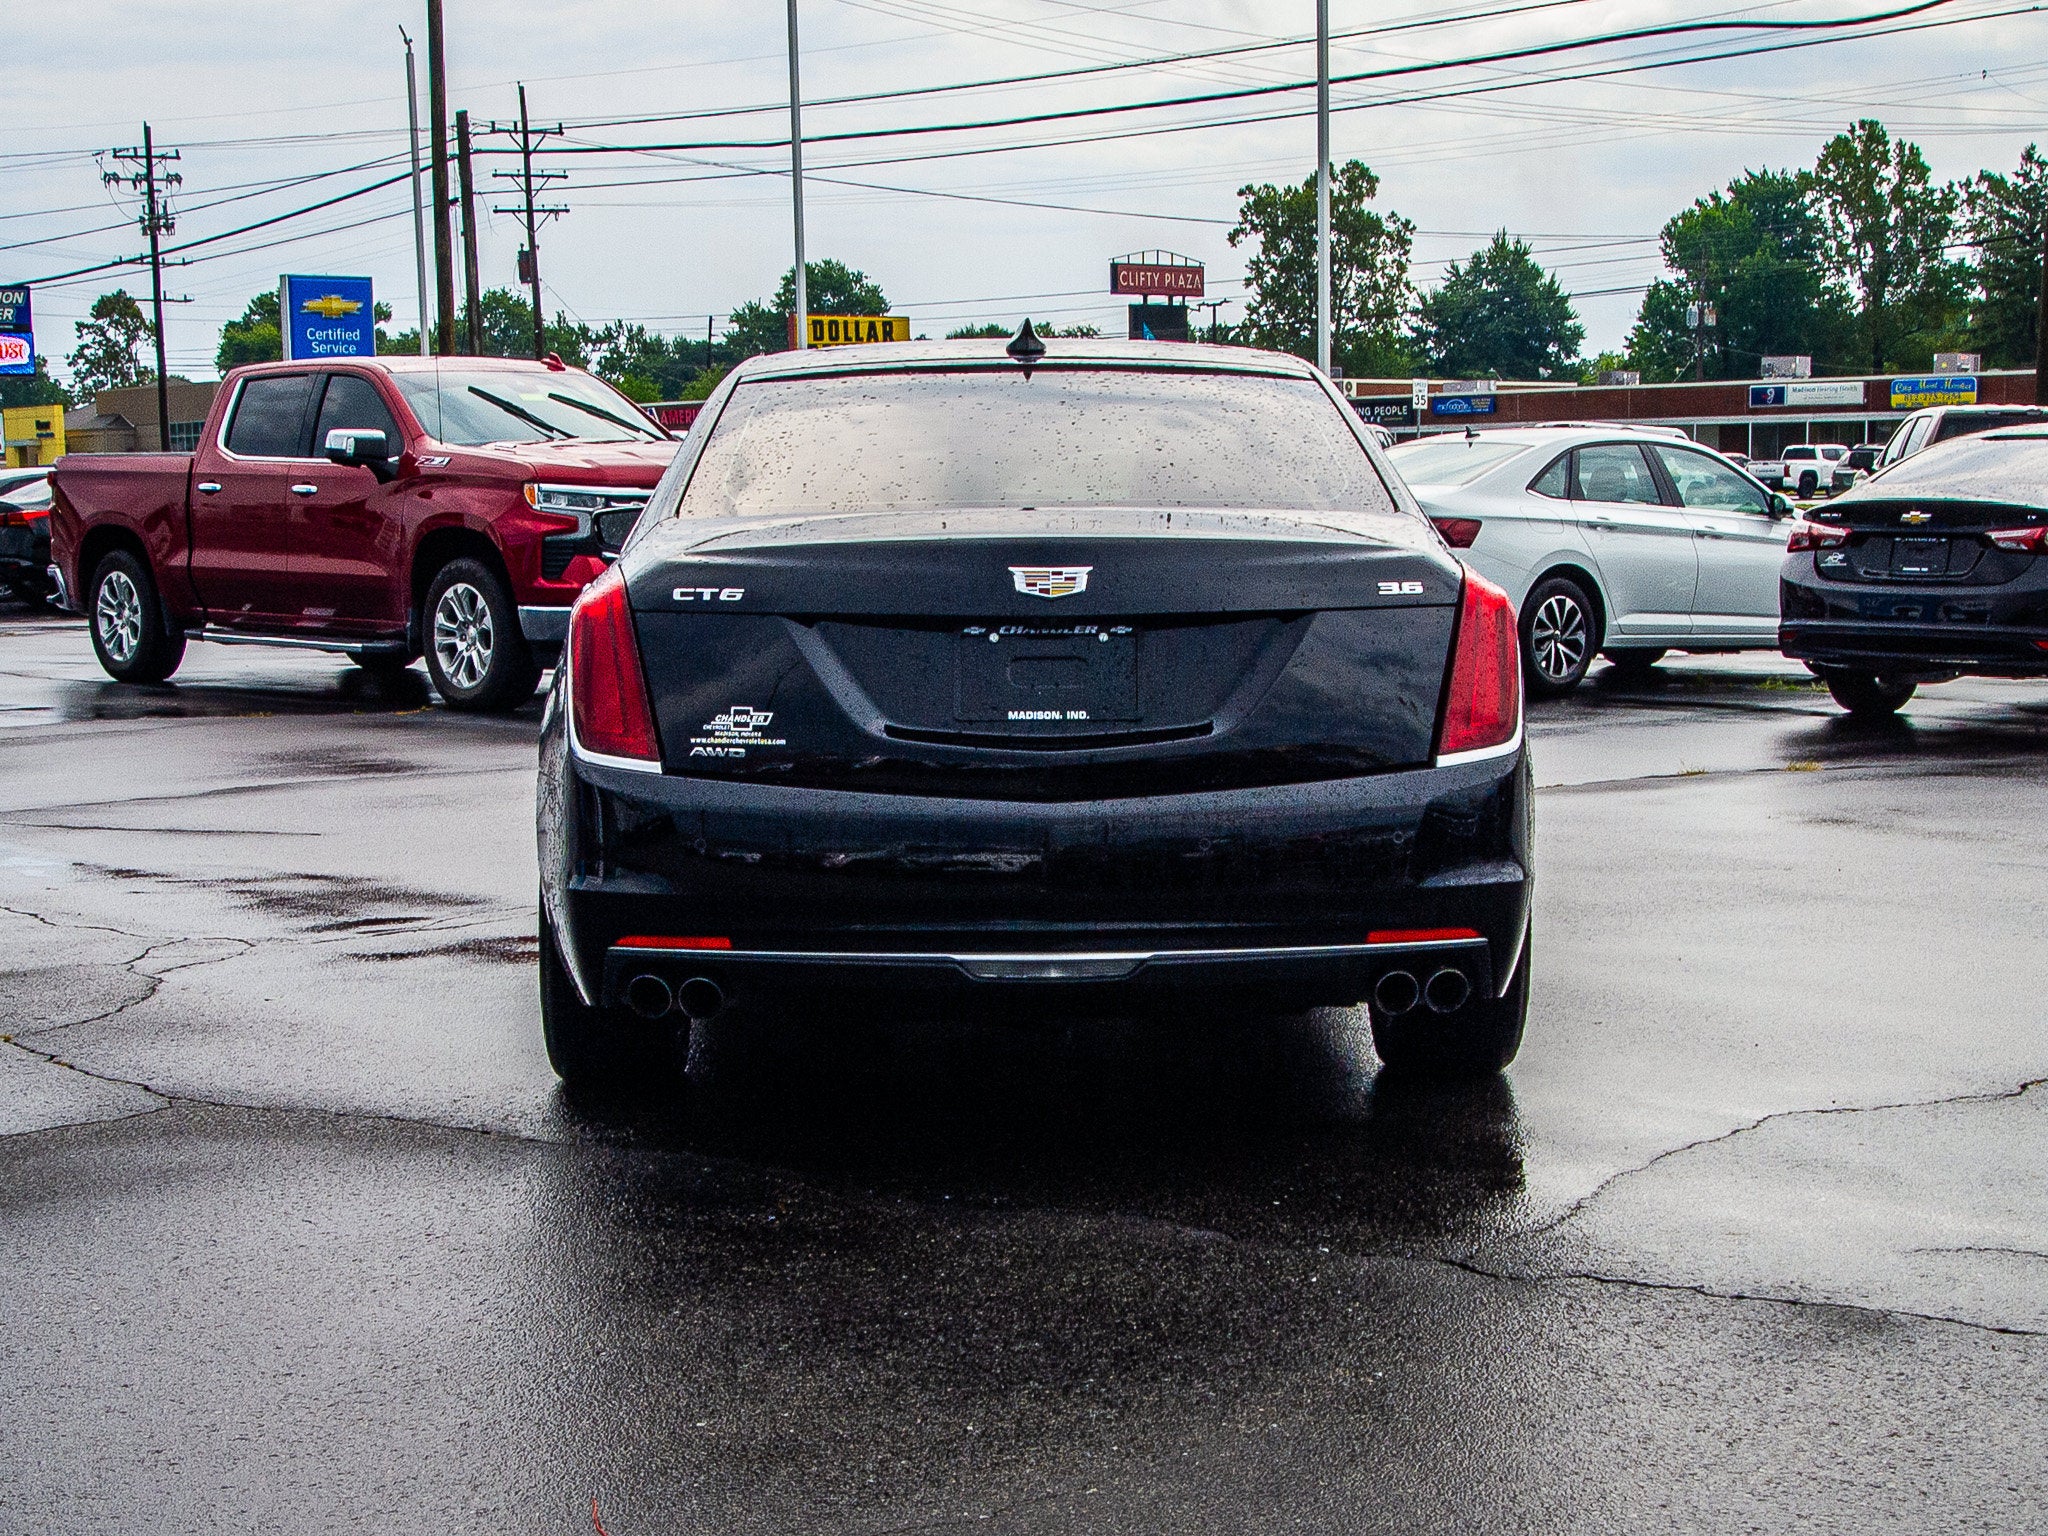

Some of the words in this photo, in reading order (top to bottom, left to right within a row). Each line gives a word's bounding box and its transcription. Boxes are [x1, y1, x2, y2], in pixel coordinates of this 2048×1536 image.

[1120, 270, 1160, 287] CLIFTY
[1165, 272, 1201, 288] PLAZA
[306, 327, 360, 340] Certified
[812, 319, 894, 342] DOLLAR
[311, 341, 356, 354] Service
[1414, 394, 1427, 406] 35
[660, 409, 700, 425] AMERI
[1374, 405, 1408, 416] PEOPLE
[672, 587, 745, 601] CT6
[715, 714, 765, 723] CHANDLER
[1066, 711, 1090, 720] IND.
[689, 746, 746, 758] AWD
